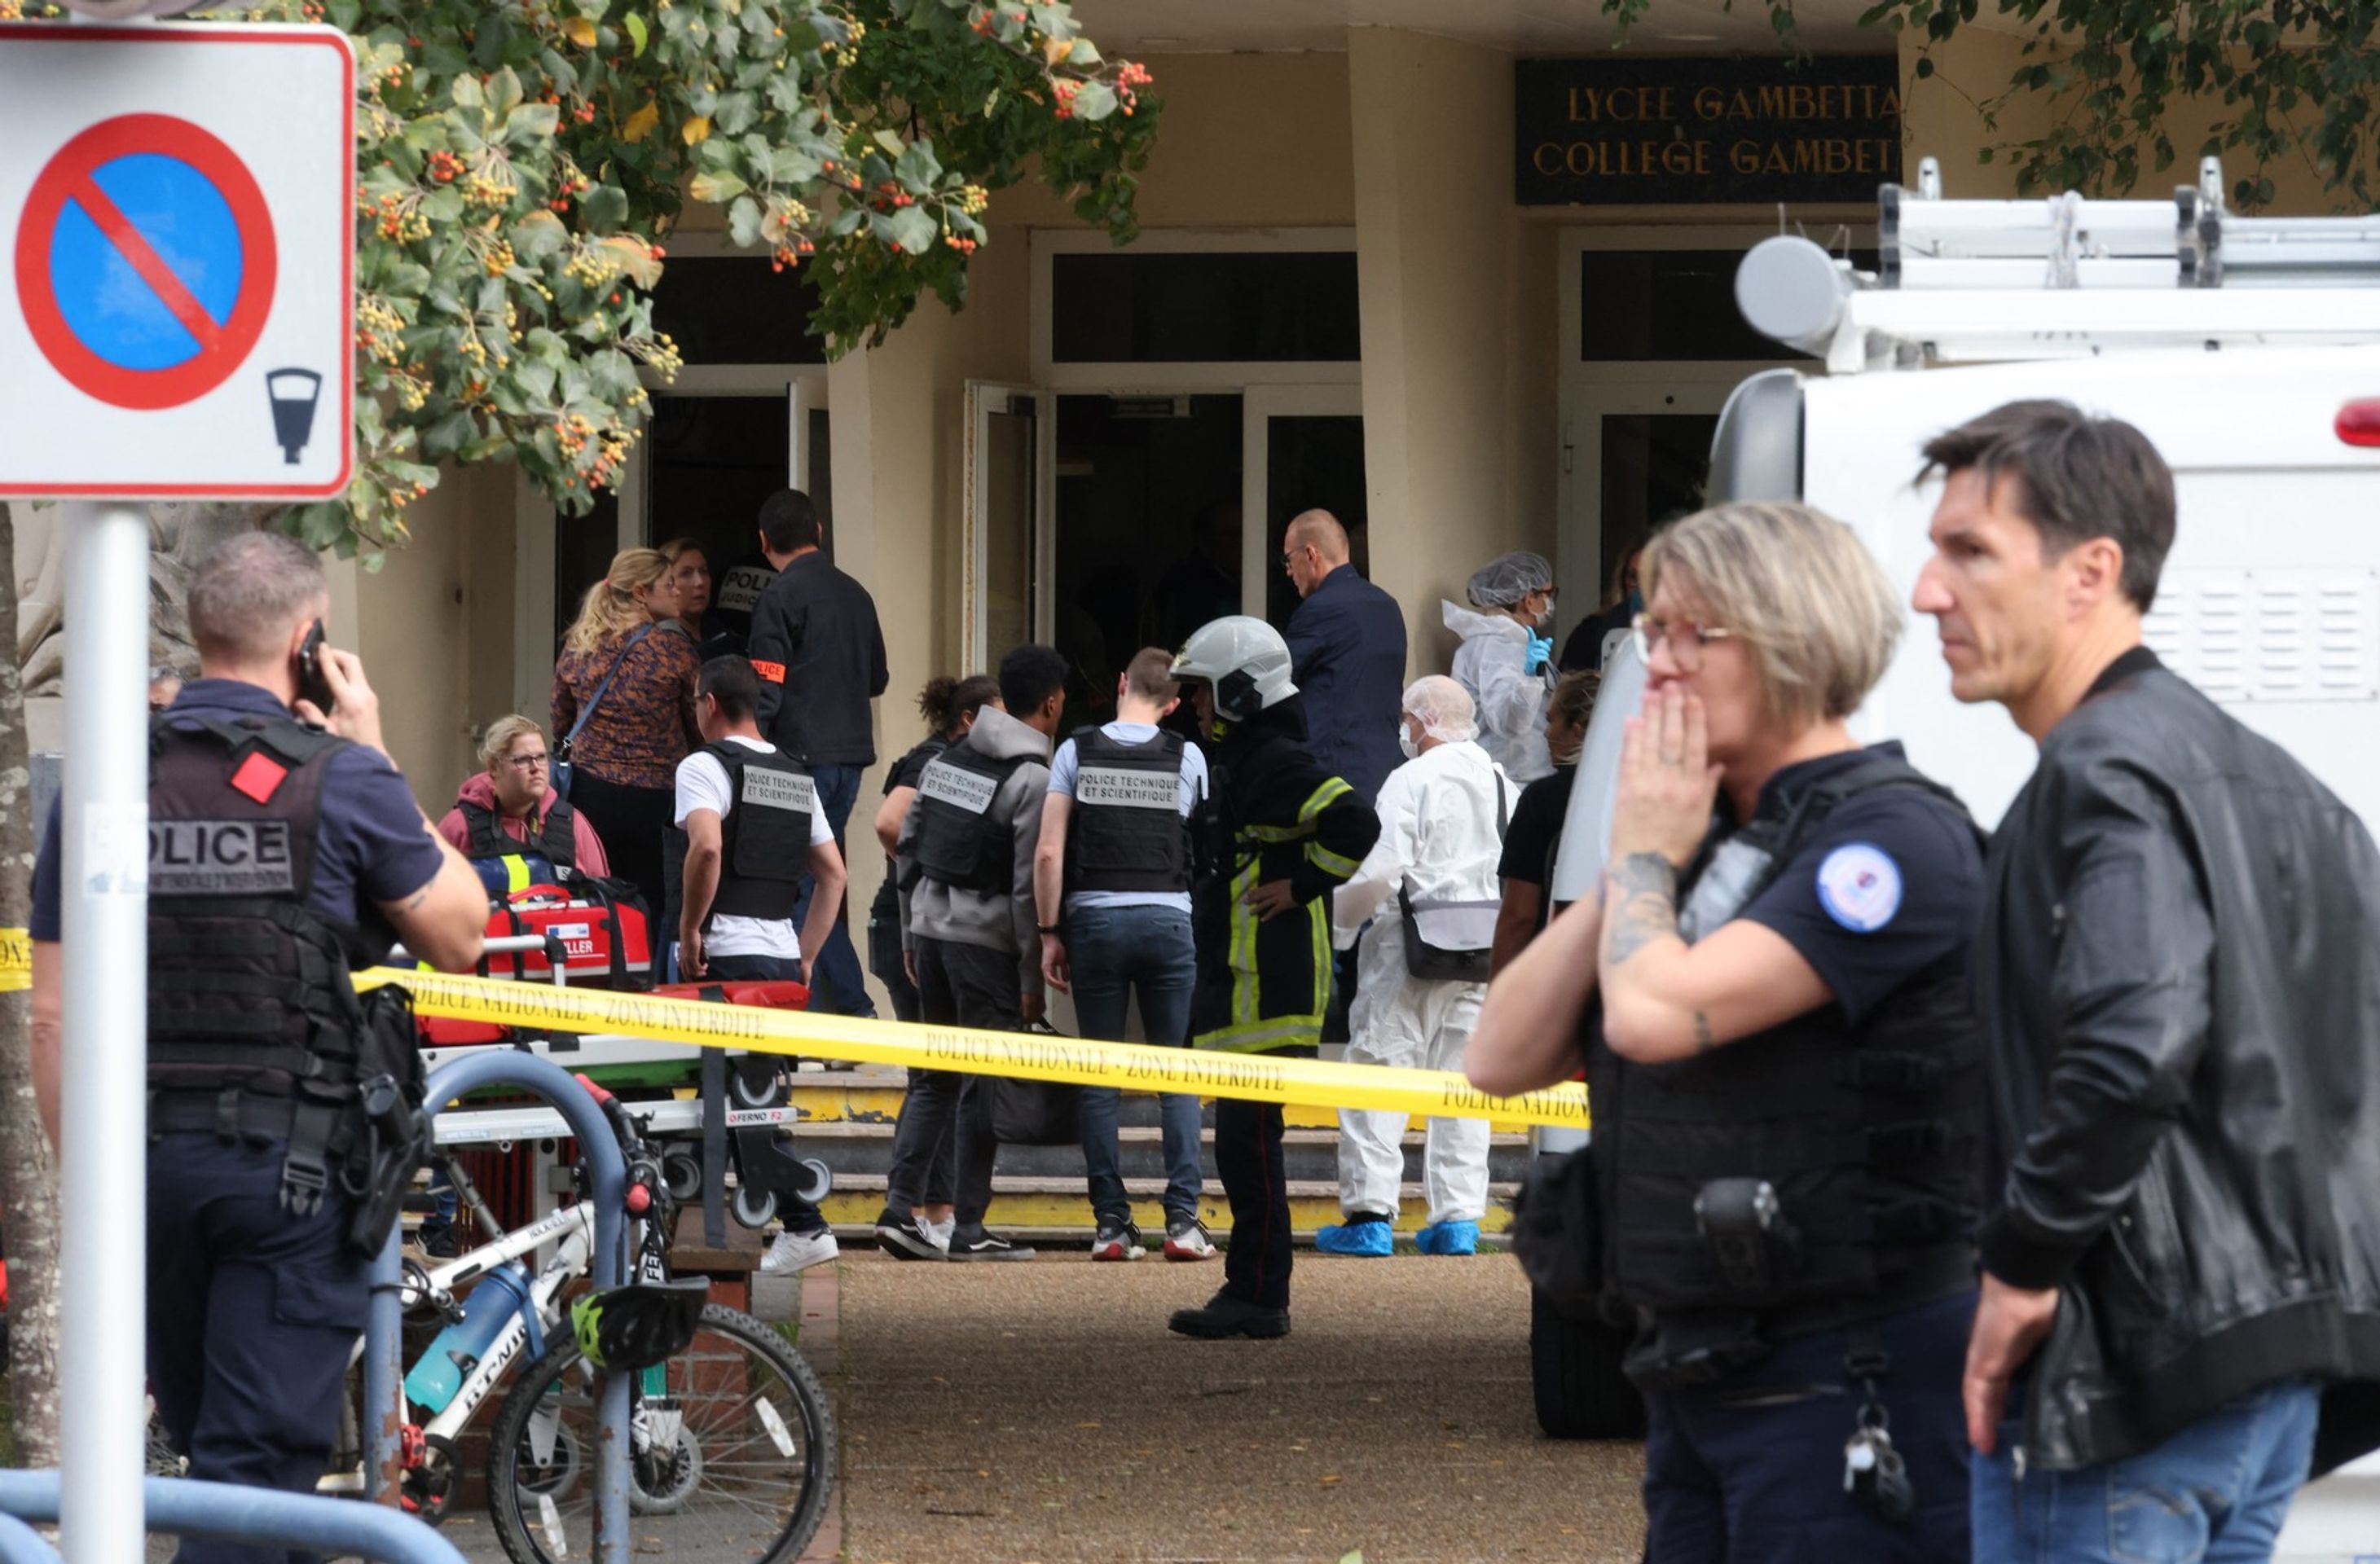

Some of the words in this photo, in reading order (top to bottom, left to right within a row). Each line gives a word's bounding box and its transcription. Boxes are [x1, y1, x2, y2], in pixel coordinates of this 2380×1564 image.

[1568, 86, 1674, 121] LYCEE
[1694, 85, 1900, 120] GAMBETTA
[1533, 142, 1710, 175] COLLEGE
[1729, 138, 1900, 174] GAMBET
[746, 771, 771, 787] POLICE
[772, 776, 814, 794] TECHNIQUE
[747, 784, 757, 796] ET
[759, 787, 810, 806] SCIENTIFIQUE
[1079, 773, 1118, 785] POLICE
[1120, 775, 1181, 790] TECHNIQUE
[1084, 786, 1098, 797] ET
[1100, 787, 1173, 802] SCIENTIFIQUE
[149, 825, 287, 865] LICE
[563, 939, 594, 954] LLER
[403, 975, 471, 1009] POLICE
[477, 983, 588, 1021] NATIONALE
[605, 997, 658, 1029] ZONE
[662, 1004, 766, 1040] INTERDITE
[926, 1031, 995, 1064] POLICE
[1001, 1039, 1109, 1075] NATIONALE
[1126, 1052, 1177, 1082] ZONE
[1182, 1057, 1286, 1092] INTERDITE
